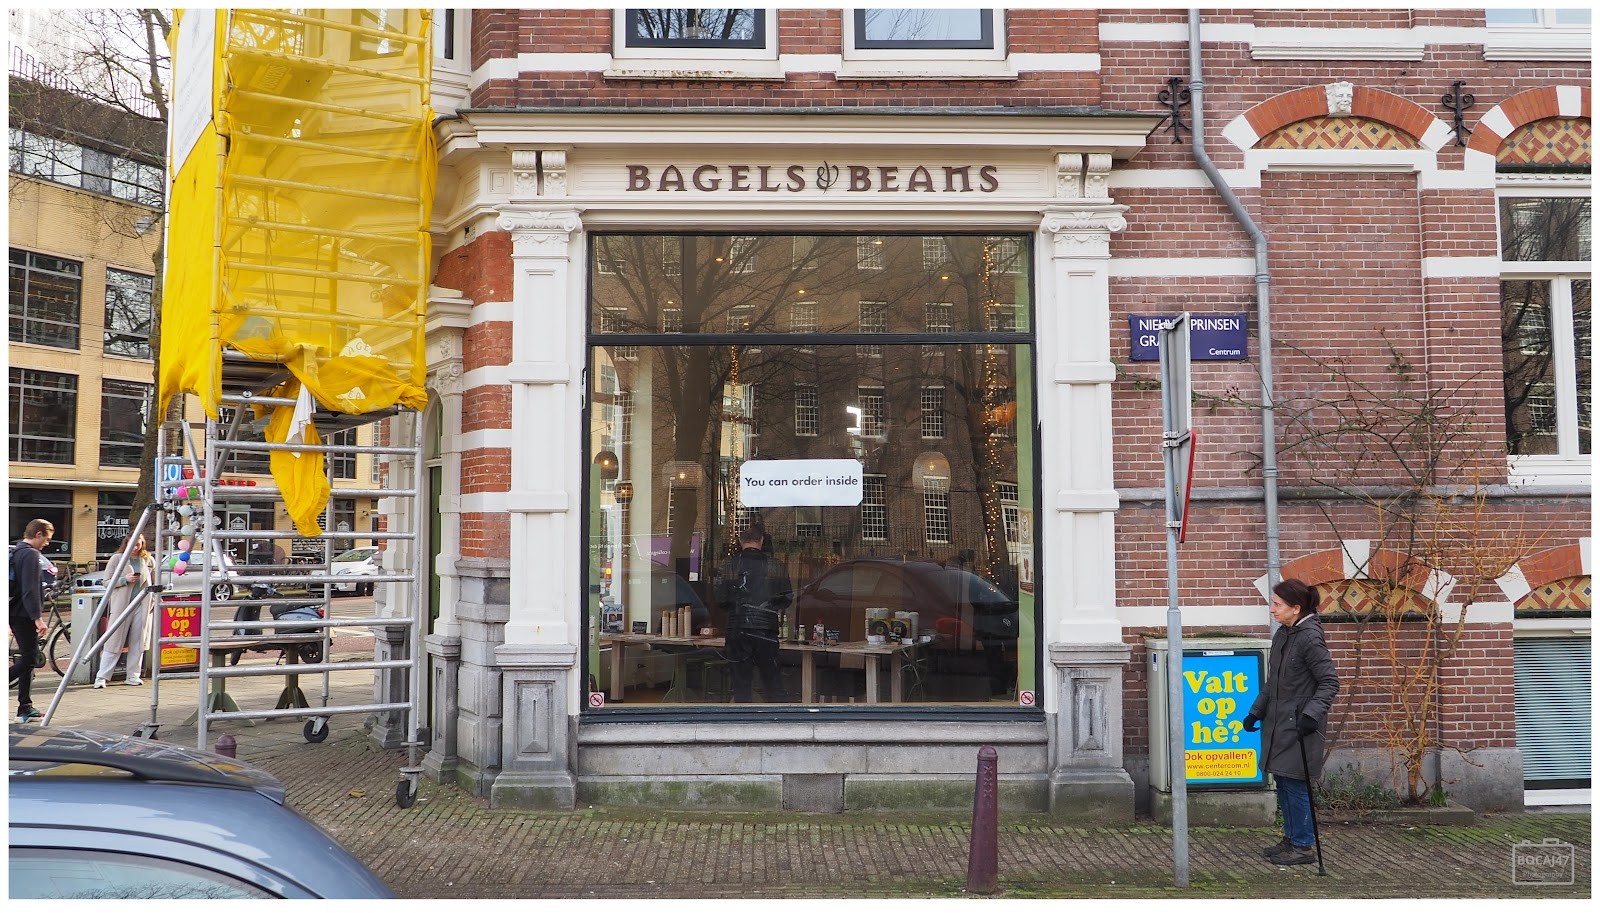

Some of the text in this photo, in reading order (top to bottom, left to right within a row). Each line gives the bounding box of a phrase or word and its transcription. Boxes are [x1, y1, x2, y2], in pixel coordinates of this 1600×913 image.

[625, 160, 999, 193] BAGELS & BEANS
[1190, 319, 1240, 331] PRINSEN
[1208, 348, 1241, 356] Centrum
[744, 477, 765, 487] You
[791, 476, 822, 486] order
[825, 475, 858, 486] inside
[171, 619, 190, 632] op
[1183, 670, 1249, 693] Valt
[1197, 697, 1237, 719] op
[1191, 720, 1244, 744] hè?
[1185, 751, 1253, 762] Ook opvallen?
[1186, 762, 1250, 770] www.centercom.nl
